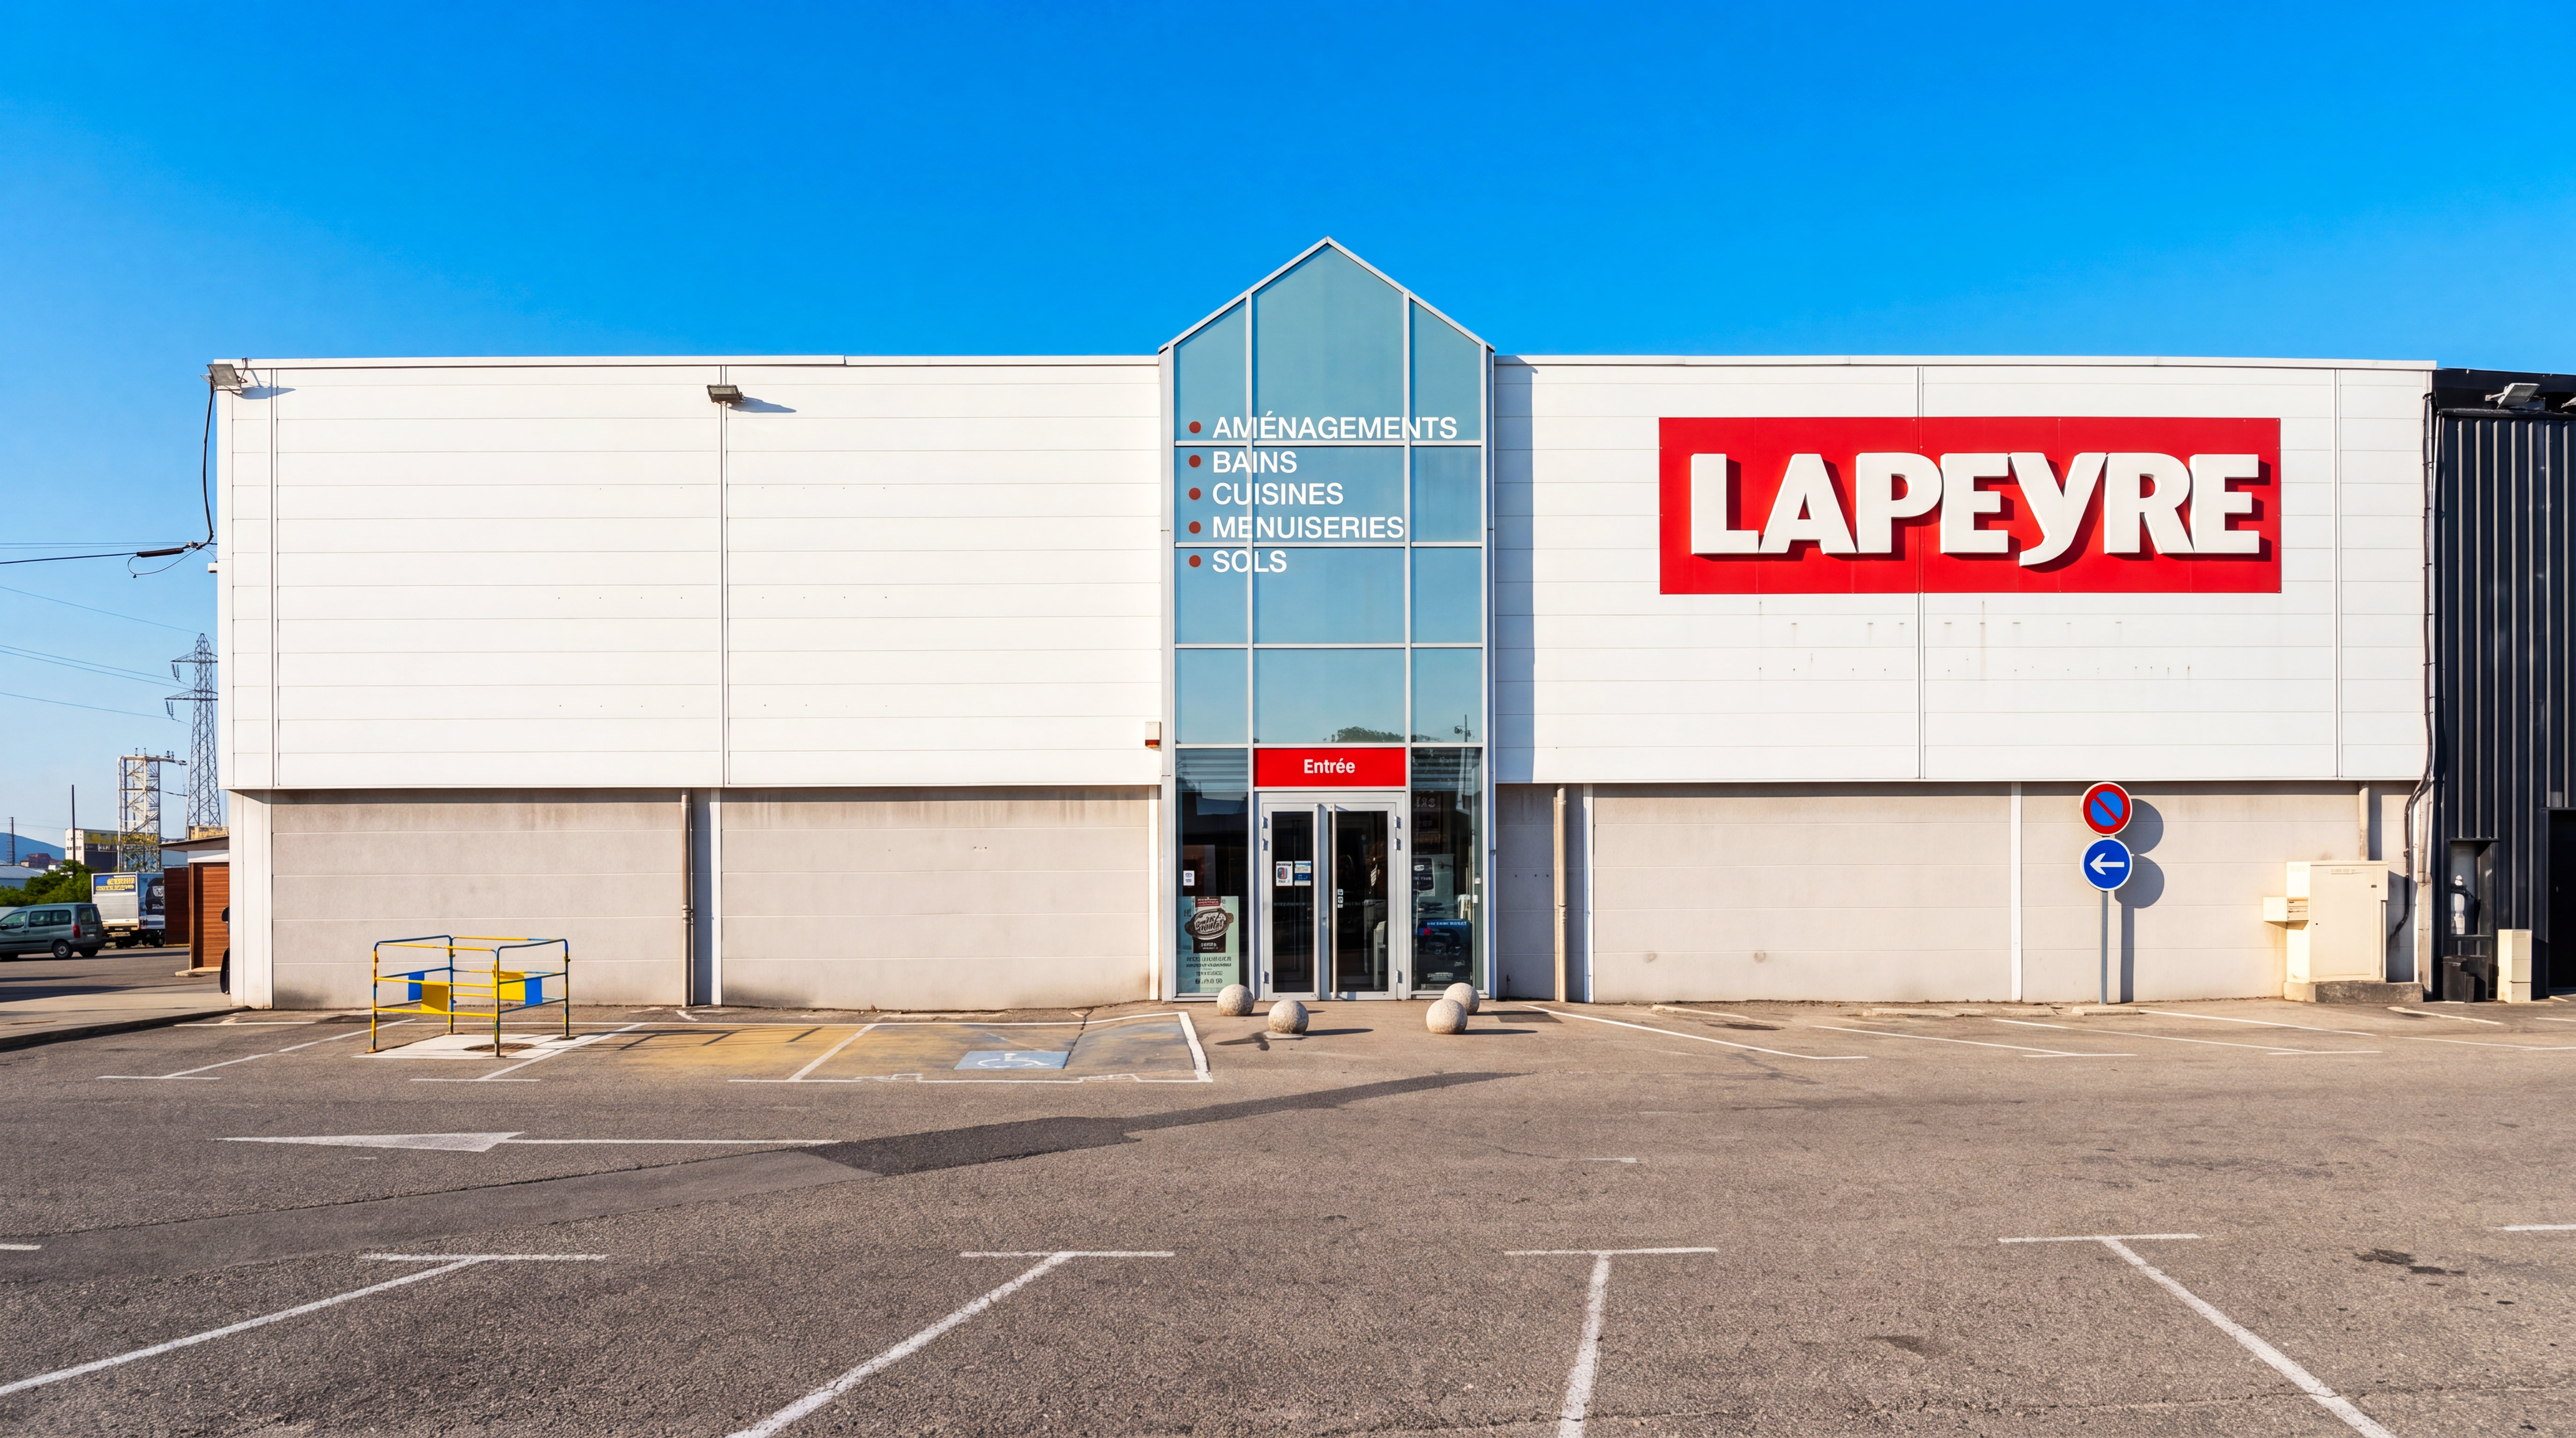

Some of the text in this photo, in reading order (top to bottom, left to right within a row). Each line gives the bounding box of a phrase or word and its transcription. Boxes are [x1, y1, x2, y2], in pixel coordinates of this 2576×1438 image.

[1212, 411, 1457, 439] AMÉNAGEMENTS
[1213, 451, 1297, 474] BAINS
[1212, 482, 1344, 505] CUISINES
[1213, 516, 1404, 539] MENUISERIES
[1212, 550, 1287, 573] SOLS
[1304, 758, 1355, 774] Entrée
